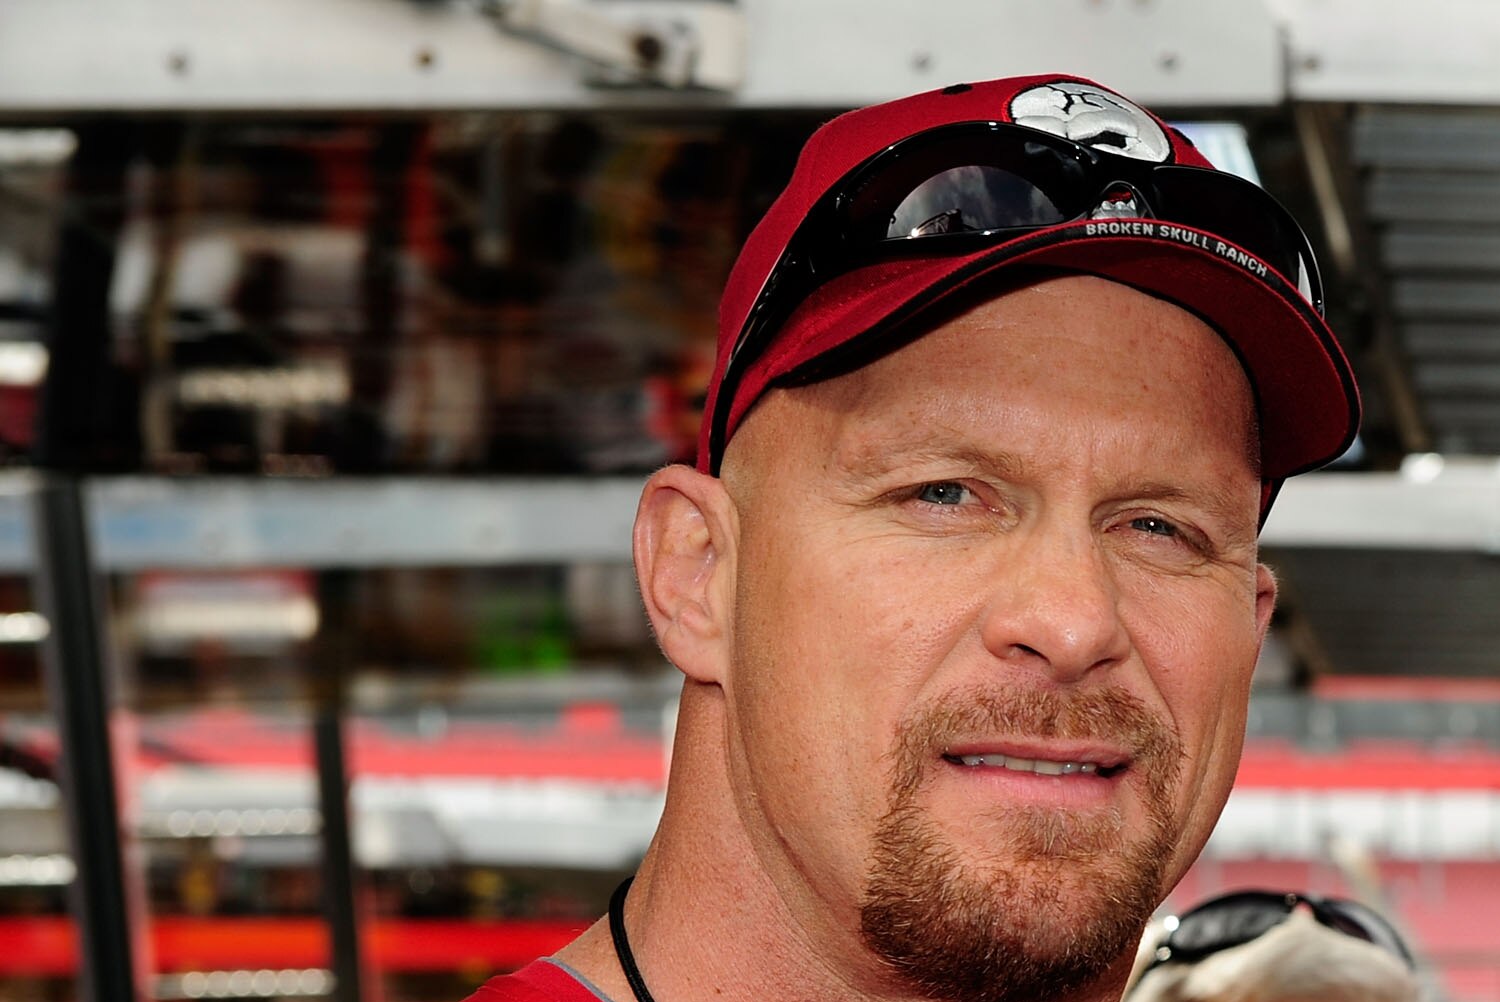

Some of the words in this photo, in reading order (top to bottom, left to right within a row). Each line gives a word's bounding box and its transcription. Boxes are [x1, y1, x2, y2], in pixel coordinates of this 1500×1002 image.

[1086, 222, 1154, 236] BROKEN
[1159, 225, 1210, 250] SKULL
[1216, 242, 1268, 277] RANCH
